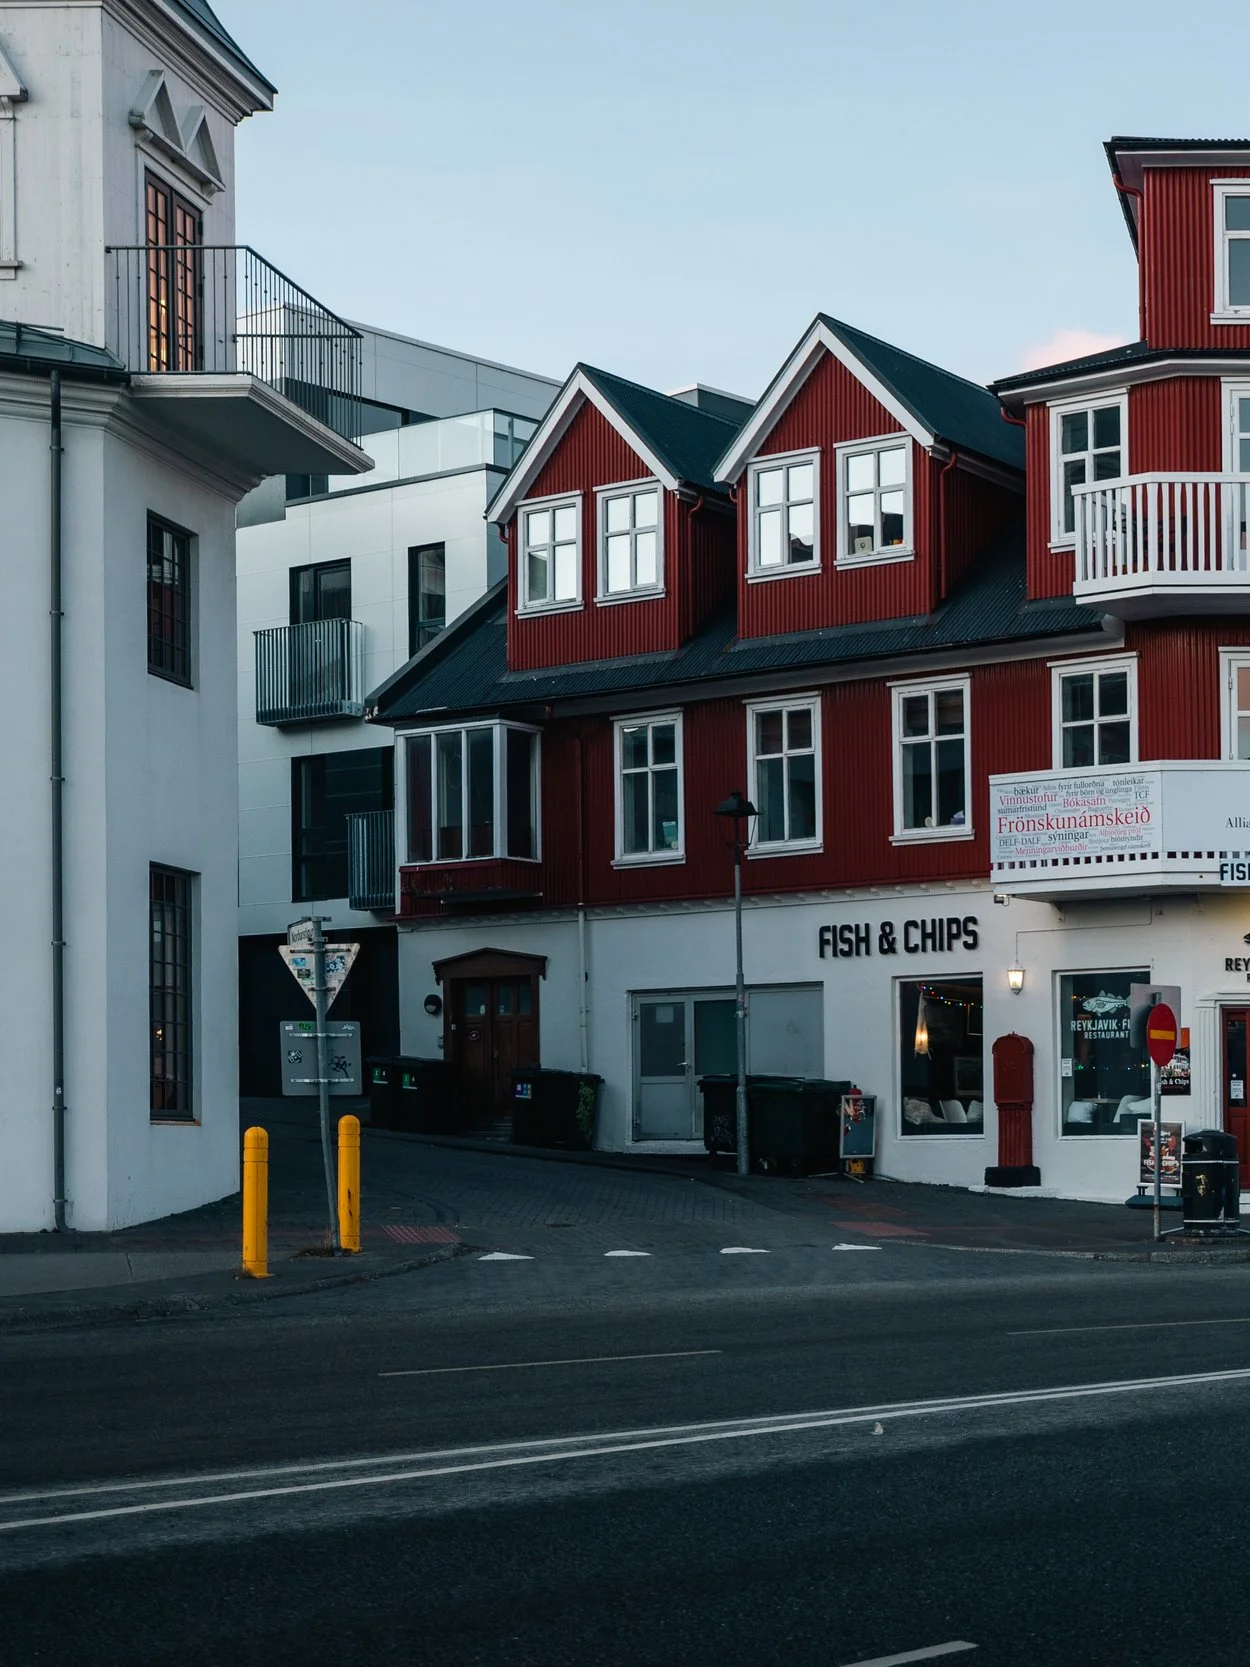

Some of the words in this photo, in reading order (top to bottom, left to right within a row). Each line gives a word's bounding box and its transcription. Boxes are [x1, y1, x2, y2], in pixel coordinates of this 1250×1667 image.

[1013, 786, 1039, 796] bækur
[1058, 782, 1073, 791] fyrir
[999, 792, 1058, 806] Vinnustofur
[1135, 790, 1149, 799] TCF
[1063, 796, 1106, 808] Bókasafn
[997, 806, 1151, 834] Frönskunámskeið
[999, 836, 1041, 847] DELF-DALF
[1047, 829, 1090, 843] sýningar
[1014, 842, 1088, 856] Menningarviðburðir
[818, 922, 872, 959] FISH
[878, 920, 898, 955] &
[903, 915, 980, 954] CHIPS
[1071, 1019, 1118, 1031] REYKJAVIK
[1122, 1019, 1130, 1030] FI
[1084, 1031, 1129, 1039] RESTAURANT
